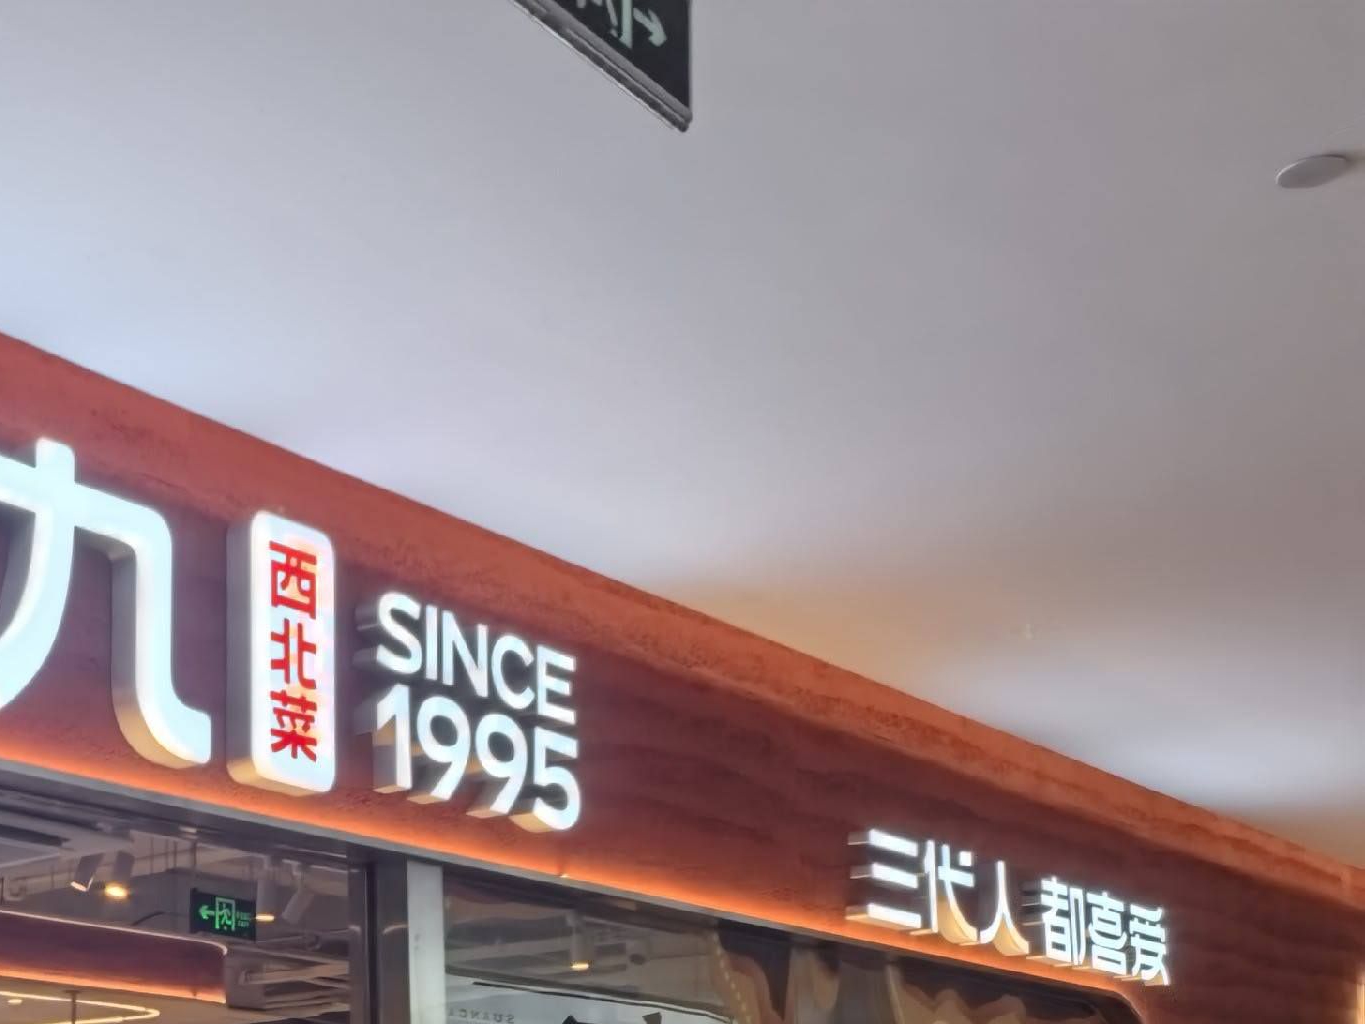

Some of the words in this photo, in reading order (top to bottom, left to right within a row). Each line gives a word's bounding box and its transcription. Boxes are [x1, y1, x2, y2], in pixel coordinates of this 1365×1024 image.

[268, 540, 318, 763] 西北菜
[375, 591, 576, 725] SINCE
[375, 683, 581, 830] 1995
[864, 828, 1171, 986] 三代人都喜爱
